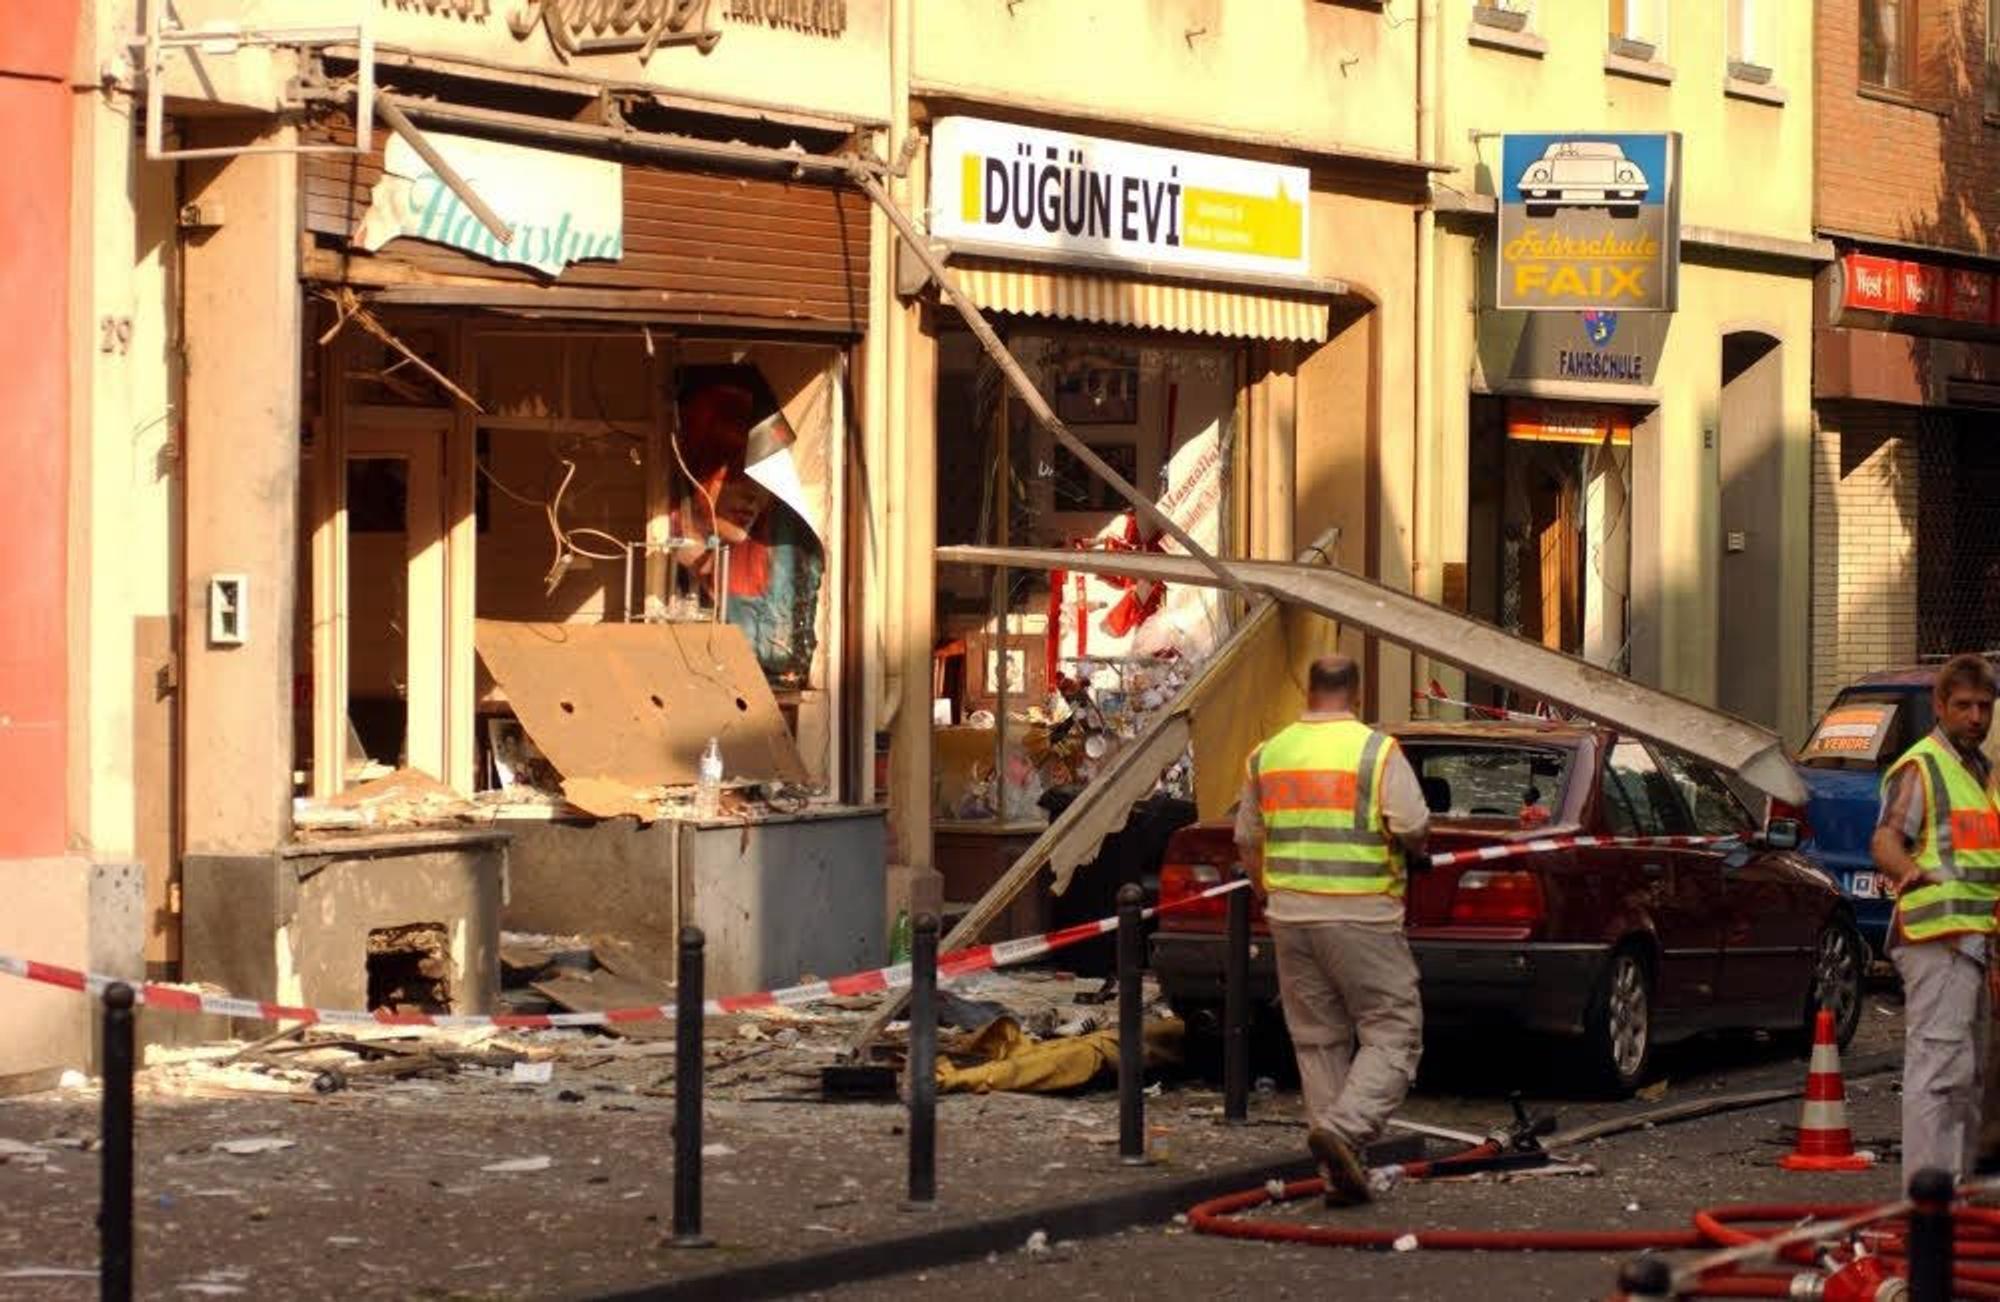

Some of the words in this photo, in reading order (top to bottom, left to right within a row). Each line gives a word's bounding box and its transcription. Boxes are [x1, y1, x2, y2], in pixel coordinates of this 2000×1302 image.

[985, 142, 1112, 241] DÜĞÜN
[1121, 165, 1181, 247] EVİ
[1503, 226, 1657, 262] Fahrschule
[1514, 264, 1648, 298] FAIX
[1855, 266, 1883, 298] West
[100, 315, 132, 356] 29
[1559, 351, 1642, 380] FAHRSCHULE
[1824, 737, 1872, 752] VENDRE
